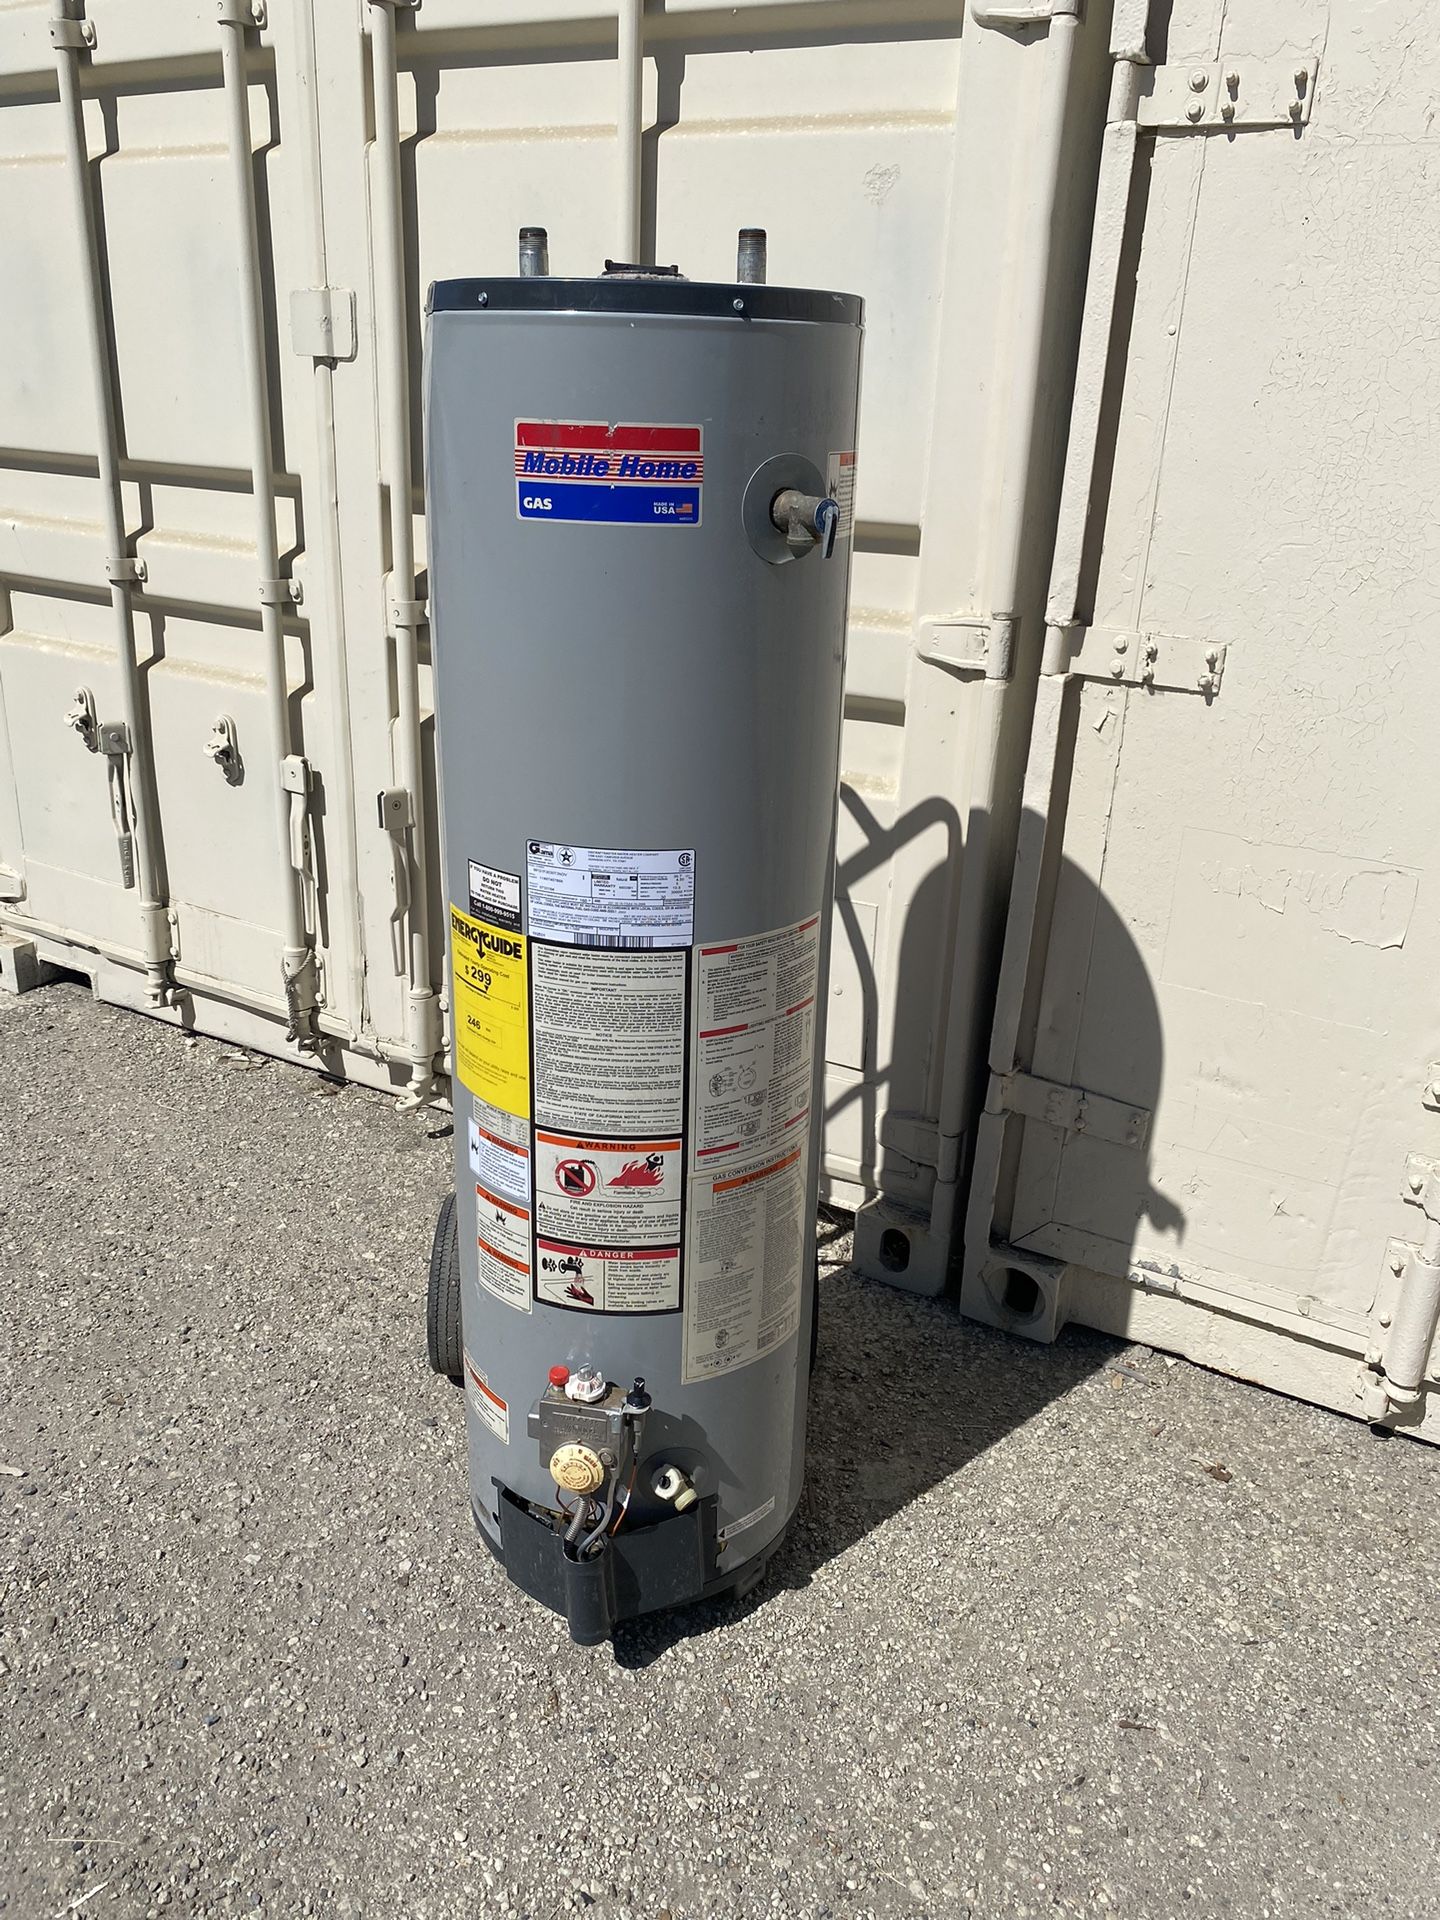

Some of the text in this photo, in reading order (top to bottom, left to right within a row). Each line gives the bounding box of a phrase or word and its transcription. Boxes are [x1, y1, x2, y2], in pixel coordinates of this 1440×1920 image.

[522, 451, 698, 479] Mobile Home
[523, 496, 552, 510] GAS
[654, 506, 676, 514] USA
[471, 966, 492, 986] 299
[585, 1142, 636, 1150] WARNING
[713, 1173, 726, 1181] GAS
[728, 1161, 764, 1177] CONVERSION
